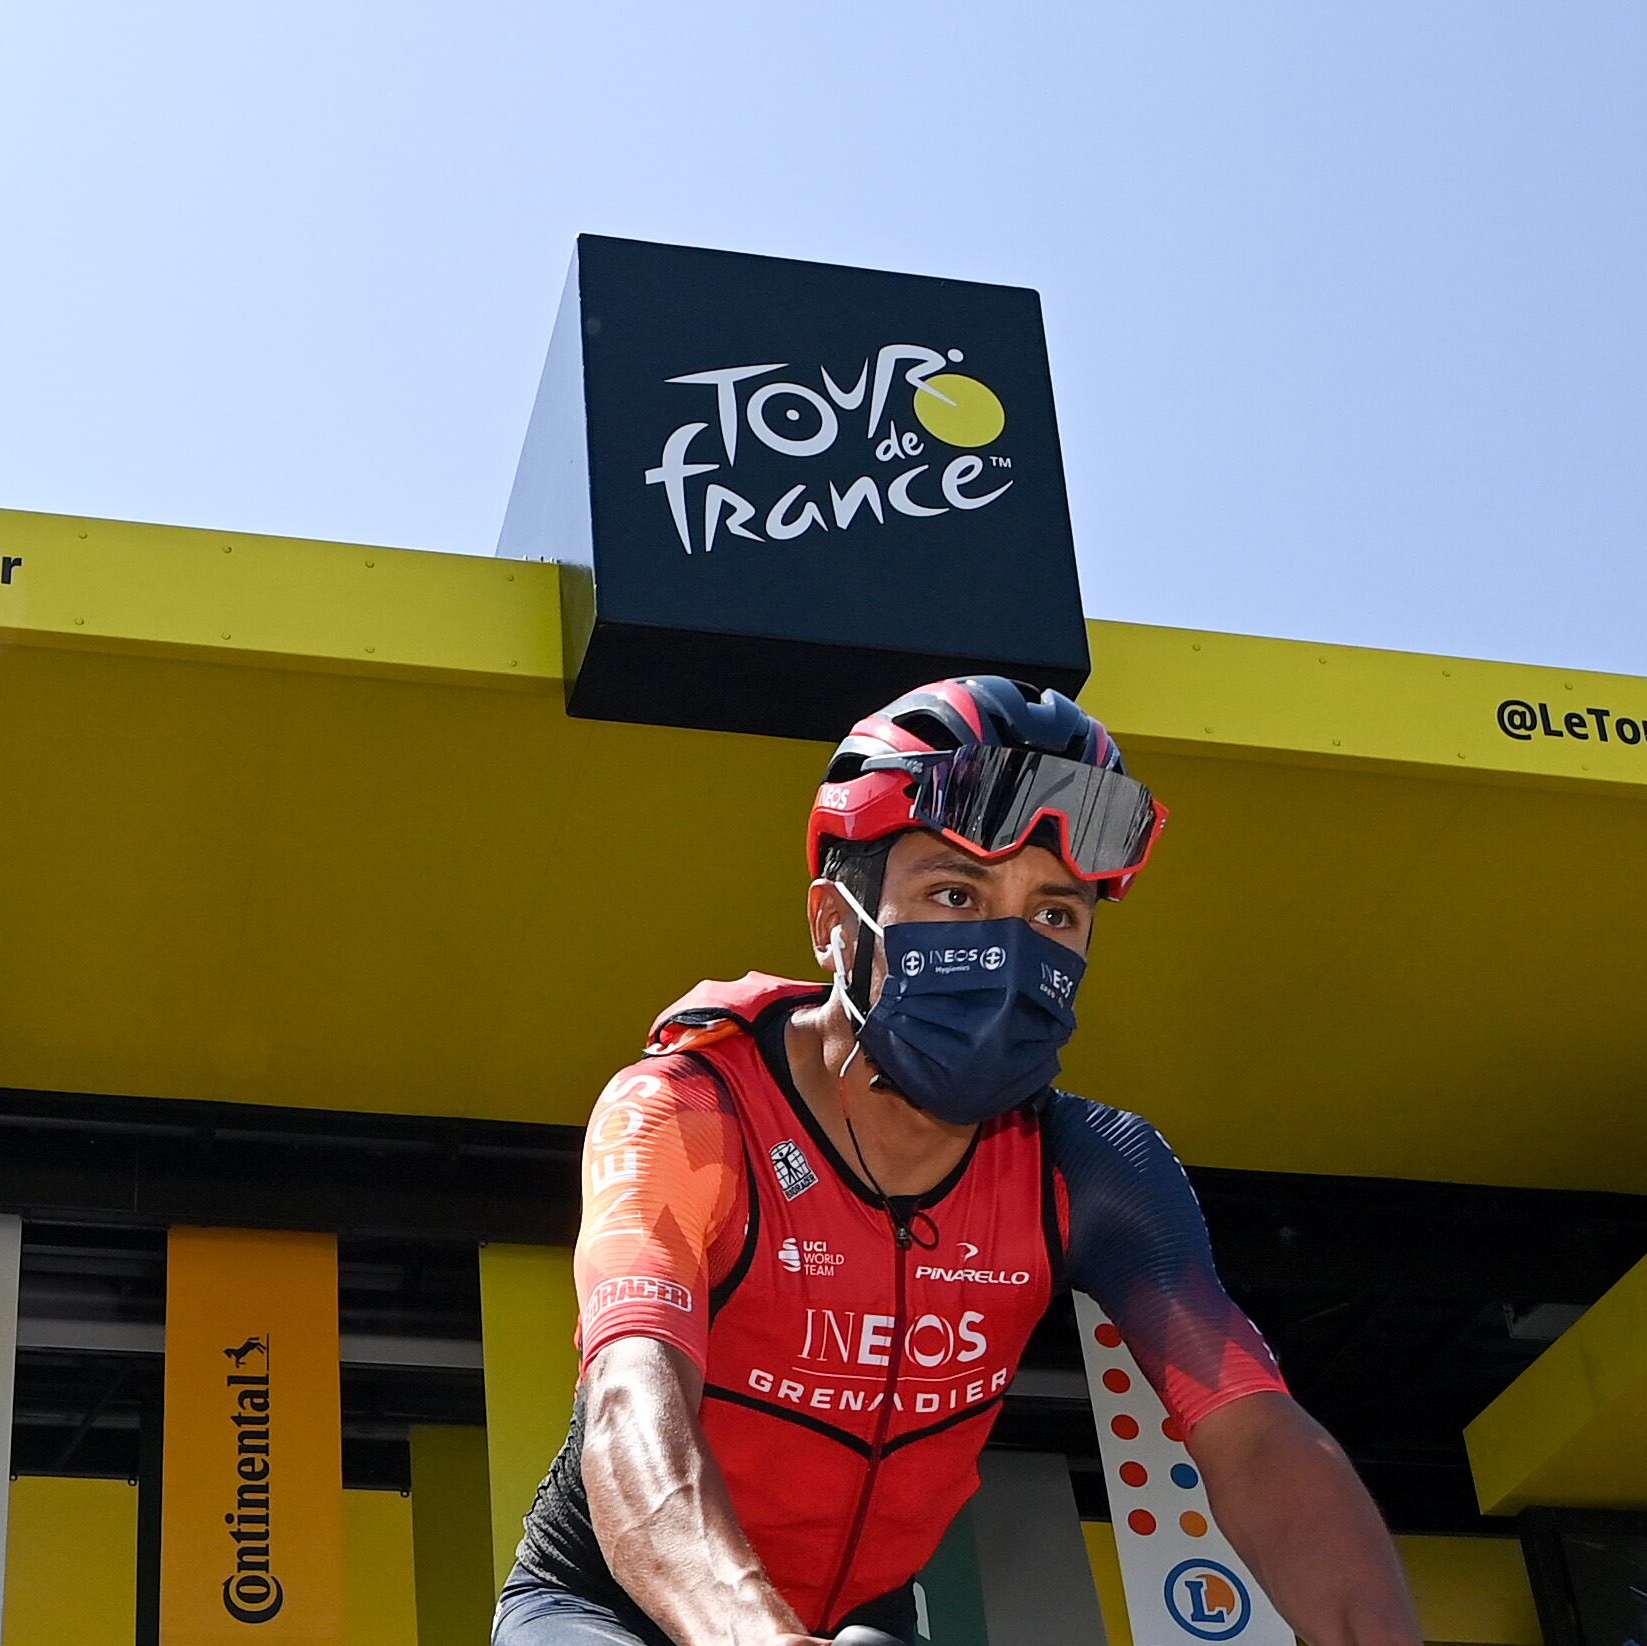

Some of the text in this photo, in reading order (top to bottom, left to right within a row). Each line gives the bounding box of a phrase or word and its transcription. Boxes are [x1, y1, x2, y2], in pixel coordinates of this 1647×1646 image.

[875, 420, 925, 462] de
[929, 948, 979, 965] INEOS
[803, 1240, 827, 1252] UCI
[803, 1252, 845, 1266] WORLD
[804, 1264, 835, 1277] TEAM
[914, 1265, 1031, 1285] PINARELLO
[797, 1308, 988, 1367] INEOS
[748, 1367, 1007, 1413] GRENADIER
[222, 1373, 284, 1625] Continental
